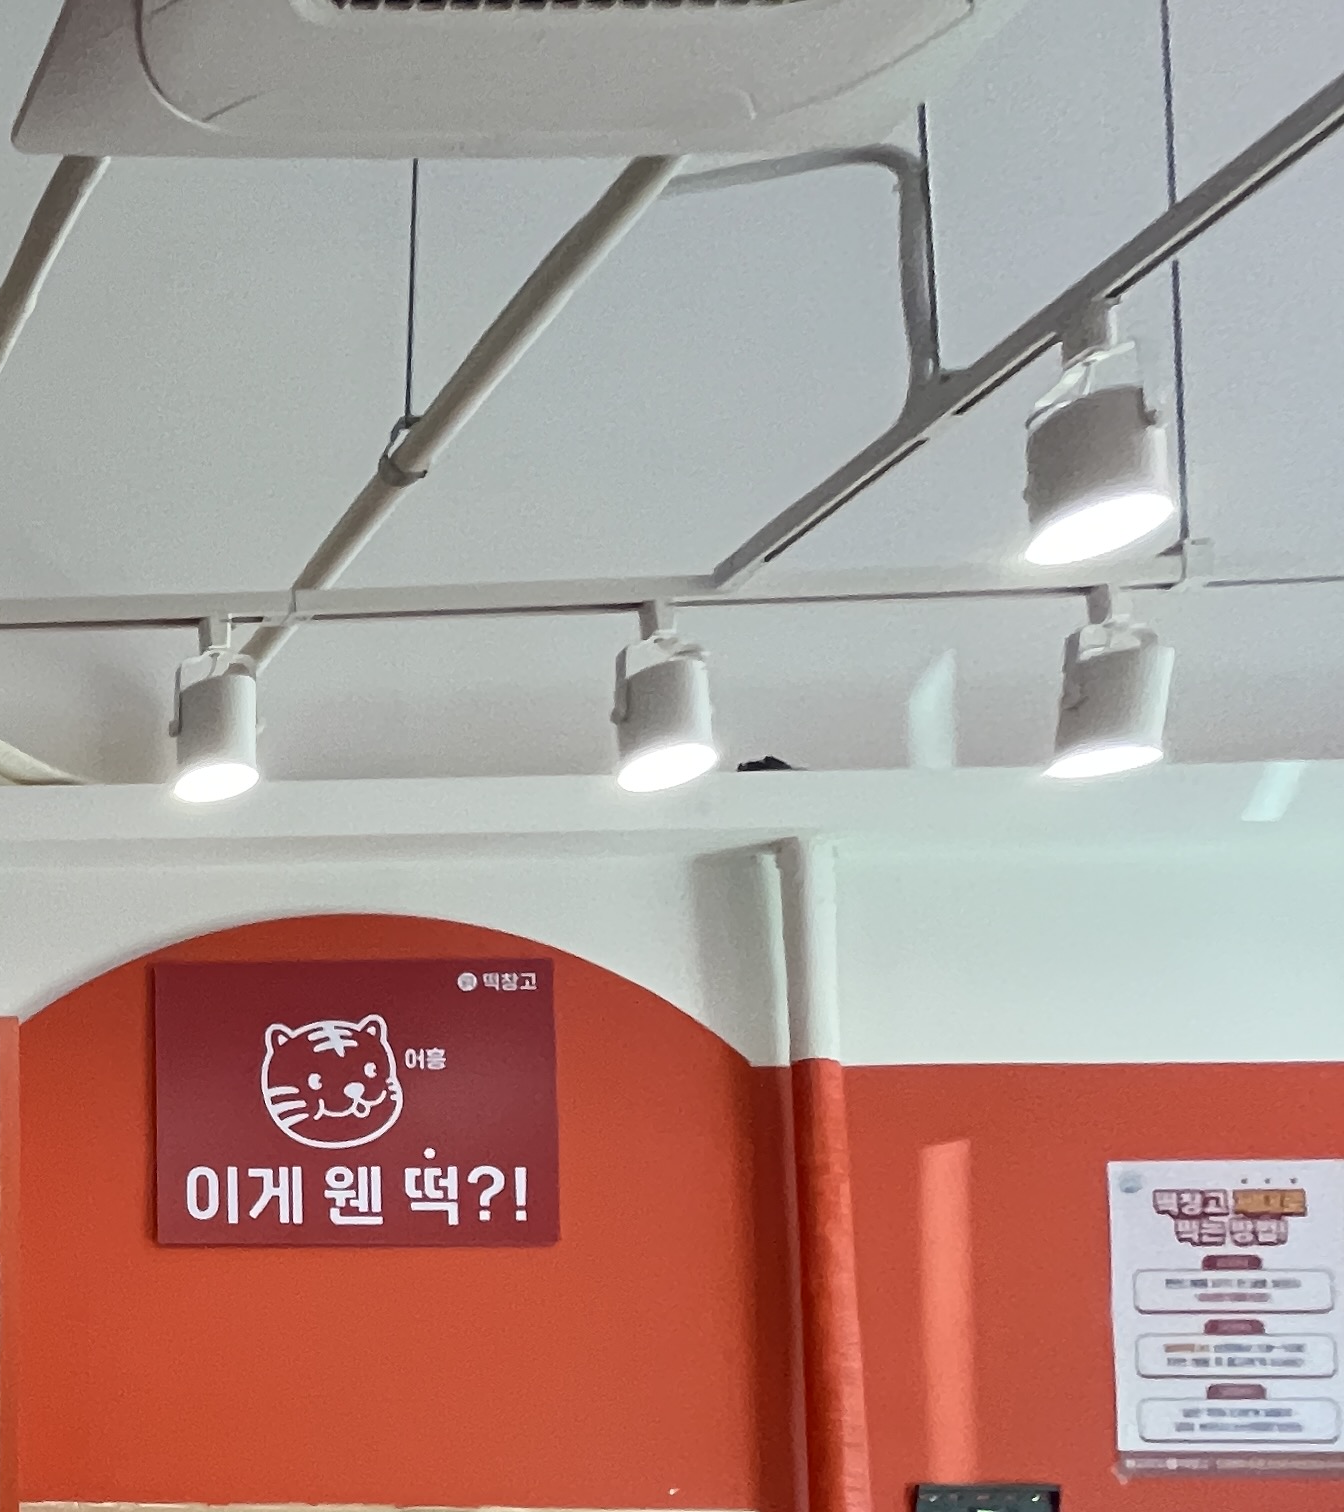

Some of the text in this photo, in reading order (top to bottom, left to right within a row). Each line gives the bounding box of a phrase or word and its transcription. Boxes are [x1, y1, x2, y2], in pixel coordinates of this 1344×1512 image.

[482, 972, 537, 991] 떡창고
[404, 1047, 447, 1070] 어흥
[185, 1165, 528, 1226] 이게 웬 떡?!
